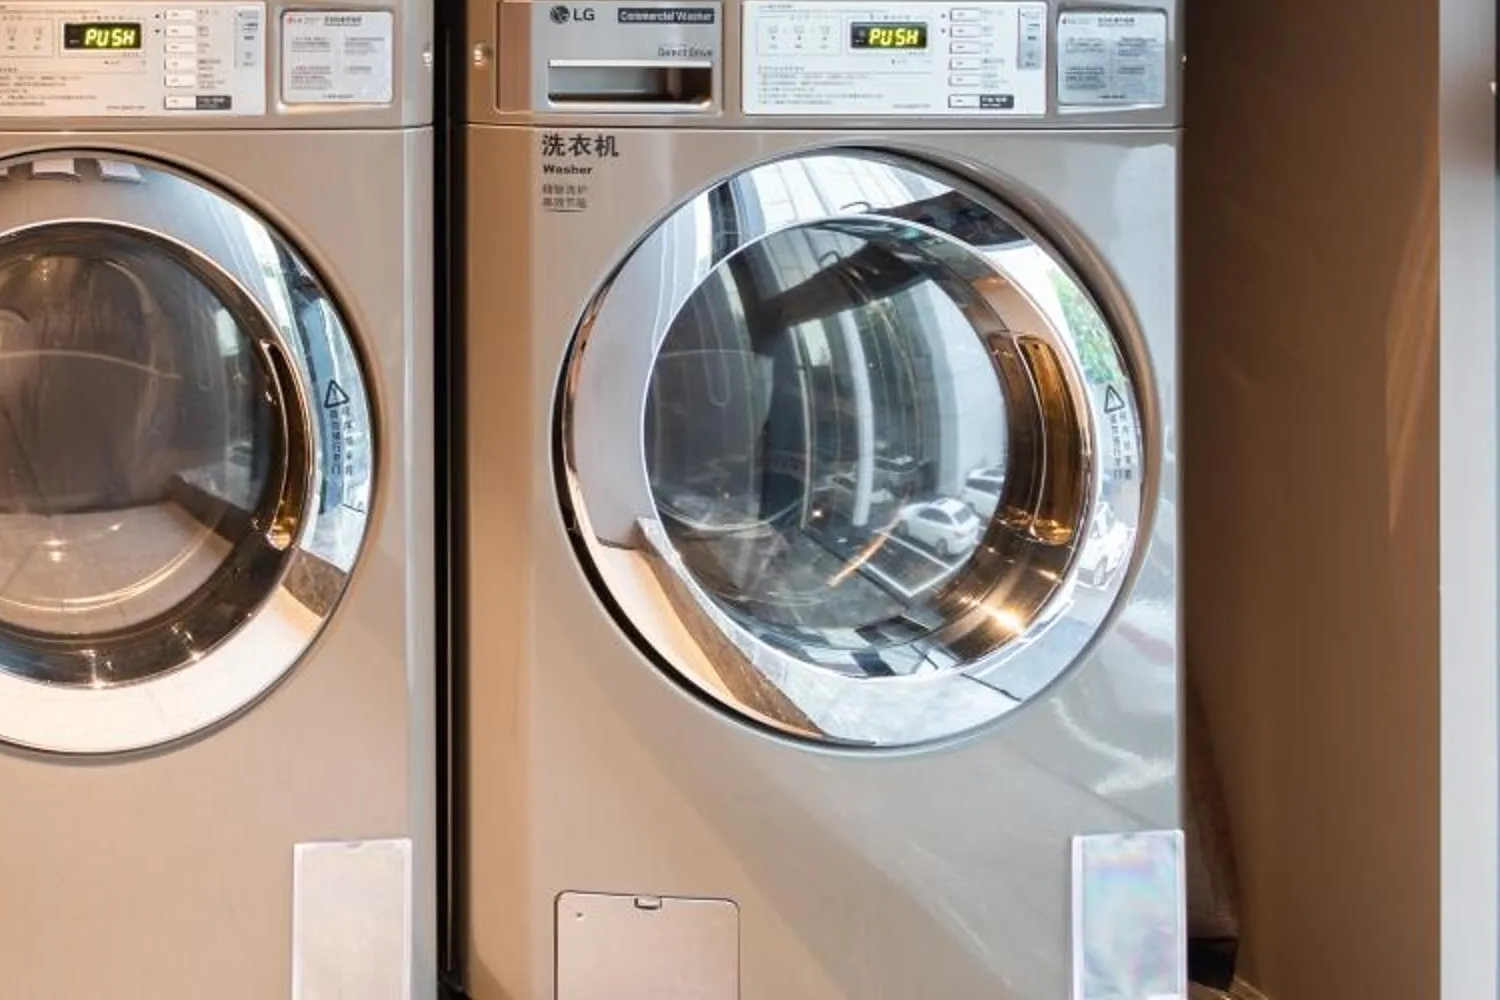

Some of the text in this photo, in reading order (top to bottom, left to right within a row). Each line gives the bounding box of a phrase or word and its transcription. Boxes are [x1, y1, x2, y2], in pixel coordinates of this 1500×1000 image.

[620, 10, 713, 21] Commercial Washer
[84, 28, 136, 47] PUSH
[868, 28, 919, 46] PUSH
[542, 133, 620, 157] 洗衣机
[543, 164, 593, 175] Washer
